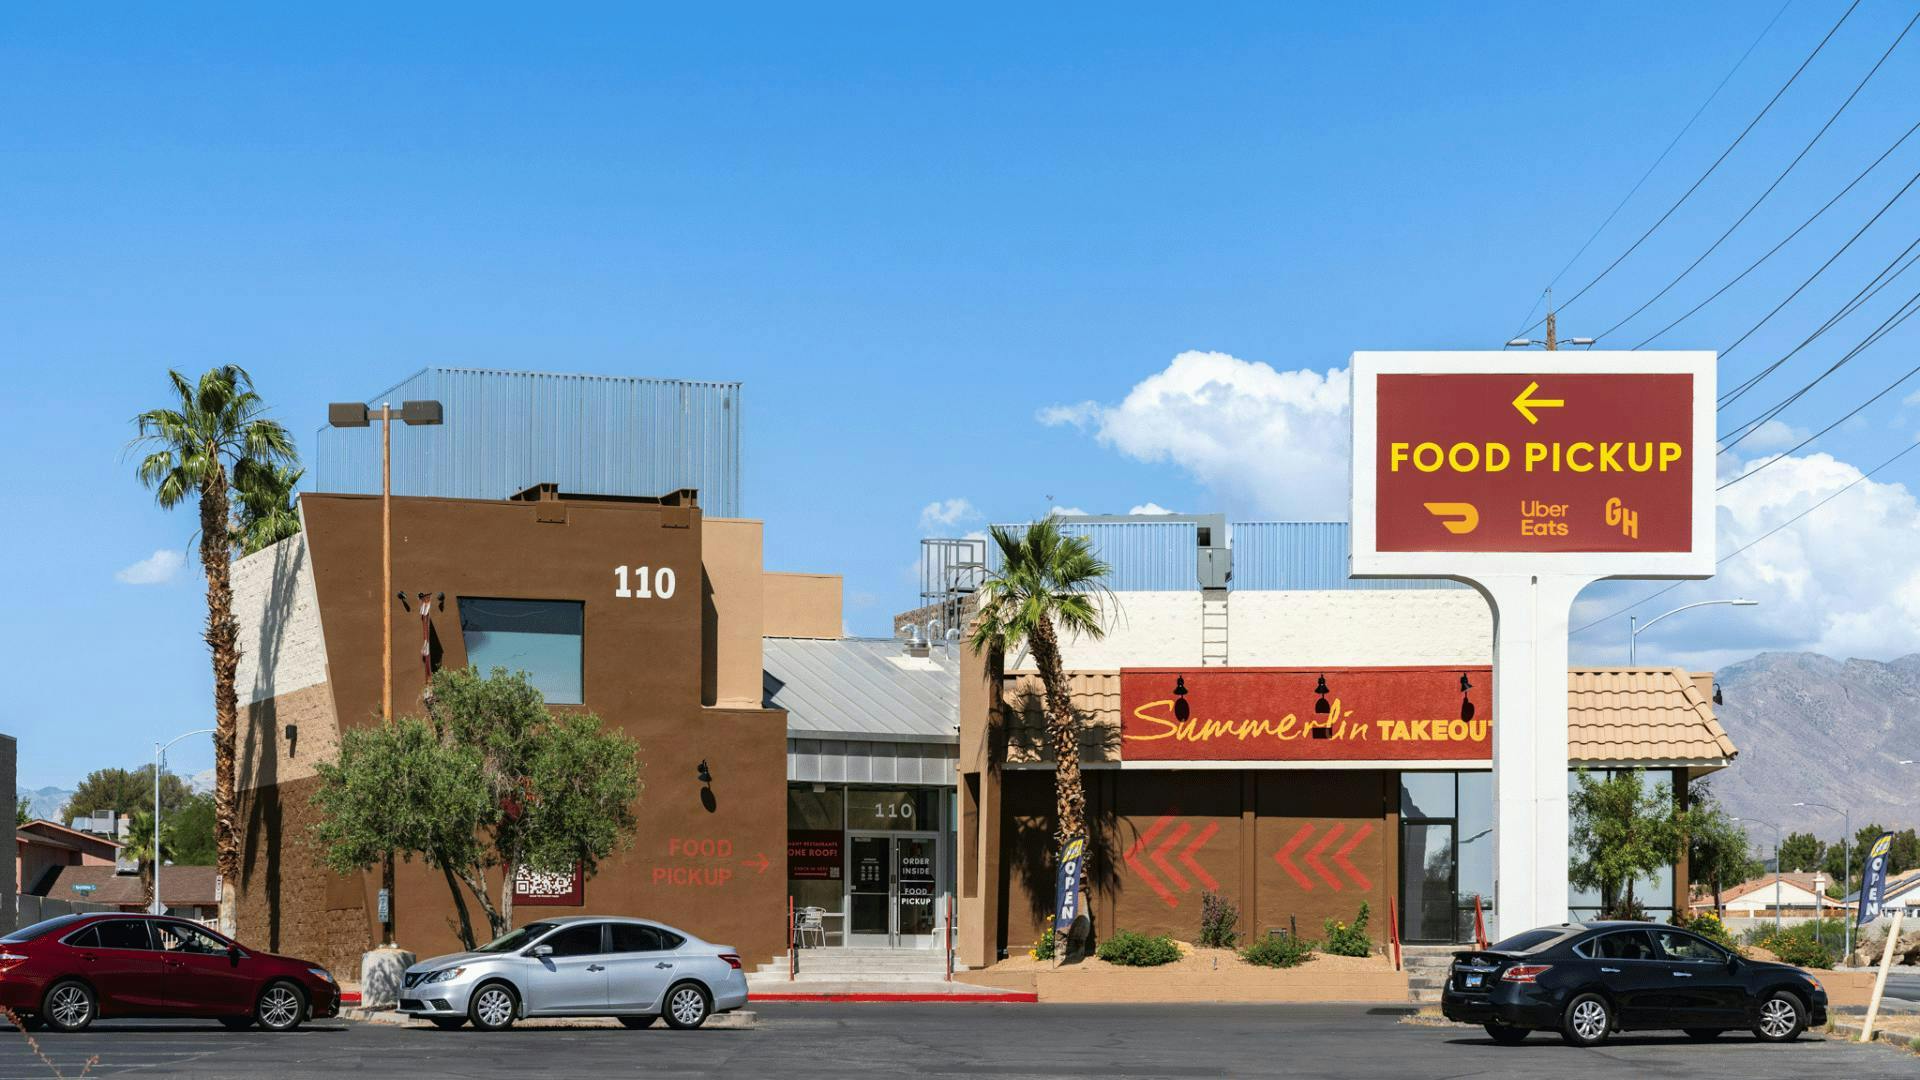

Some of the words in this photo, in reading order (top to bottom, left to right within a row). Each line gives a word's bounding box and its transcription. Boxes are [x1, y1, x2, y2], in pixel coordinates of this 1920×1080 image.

[1391, 442, 1511, 472] FOOD
[1525, 442, 1682, 472] PICKUP
[1521, 500, 1568, 517] Uber
[1521, 519, 1568, 536] Eats
[614, 565, 676, 600] 110
[1123, 698, 1367, 741] Summerlin
[875, 803, 912, 818] 110
[669, 838, 733, 857] FOOD
[788, 849, 806, 857] ONE
[902, 857, 930, 865] ORDER
[652, 866, 732, 885] PICKUP
[902, 867, 930, 875] INSIDE
[904, 888, 928, 896] FOOD
[1061, 861, 1077, 920] OPEN
[1865, 857, 1882, 916] OPEN
[901, 897, 931, 905] PICKUP
